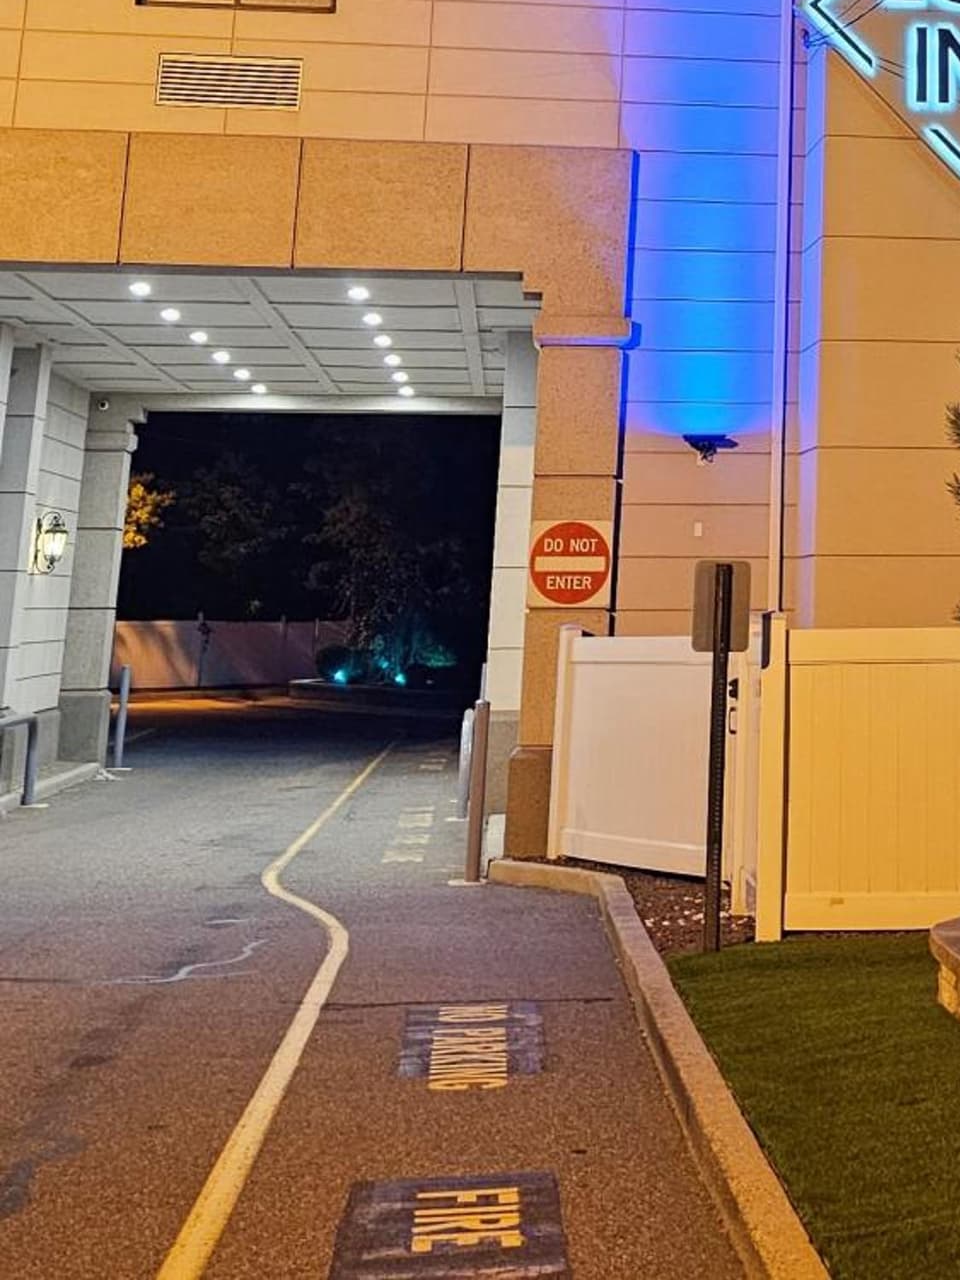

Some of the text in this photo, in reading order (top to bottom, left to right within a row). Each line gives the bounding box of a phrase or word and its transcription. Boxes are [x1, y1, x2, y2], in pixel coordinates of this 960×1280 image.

[543, 538, 599, 553] DO NOT
[546, 576, 592, 590] ENTER
[427, 1026, 508, 1091] PARKING
[410, 1186, 522, 1253] FIRE
